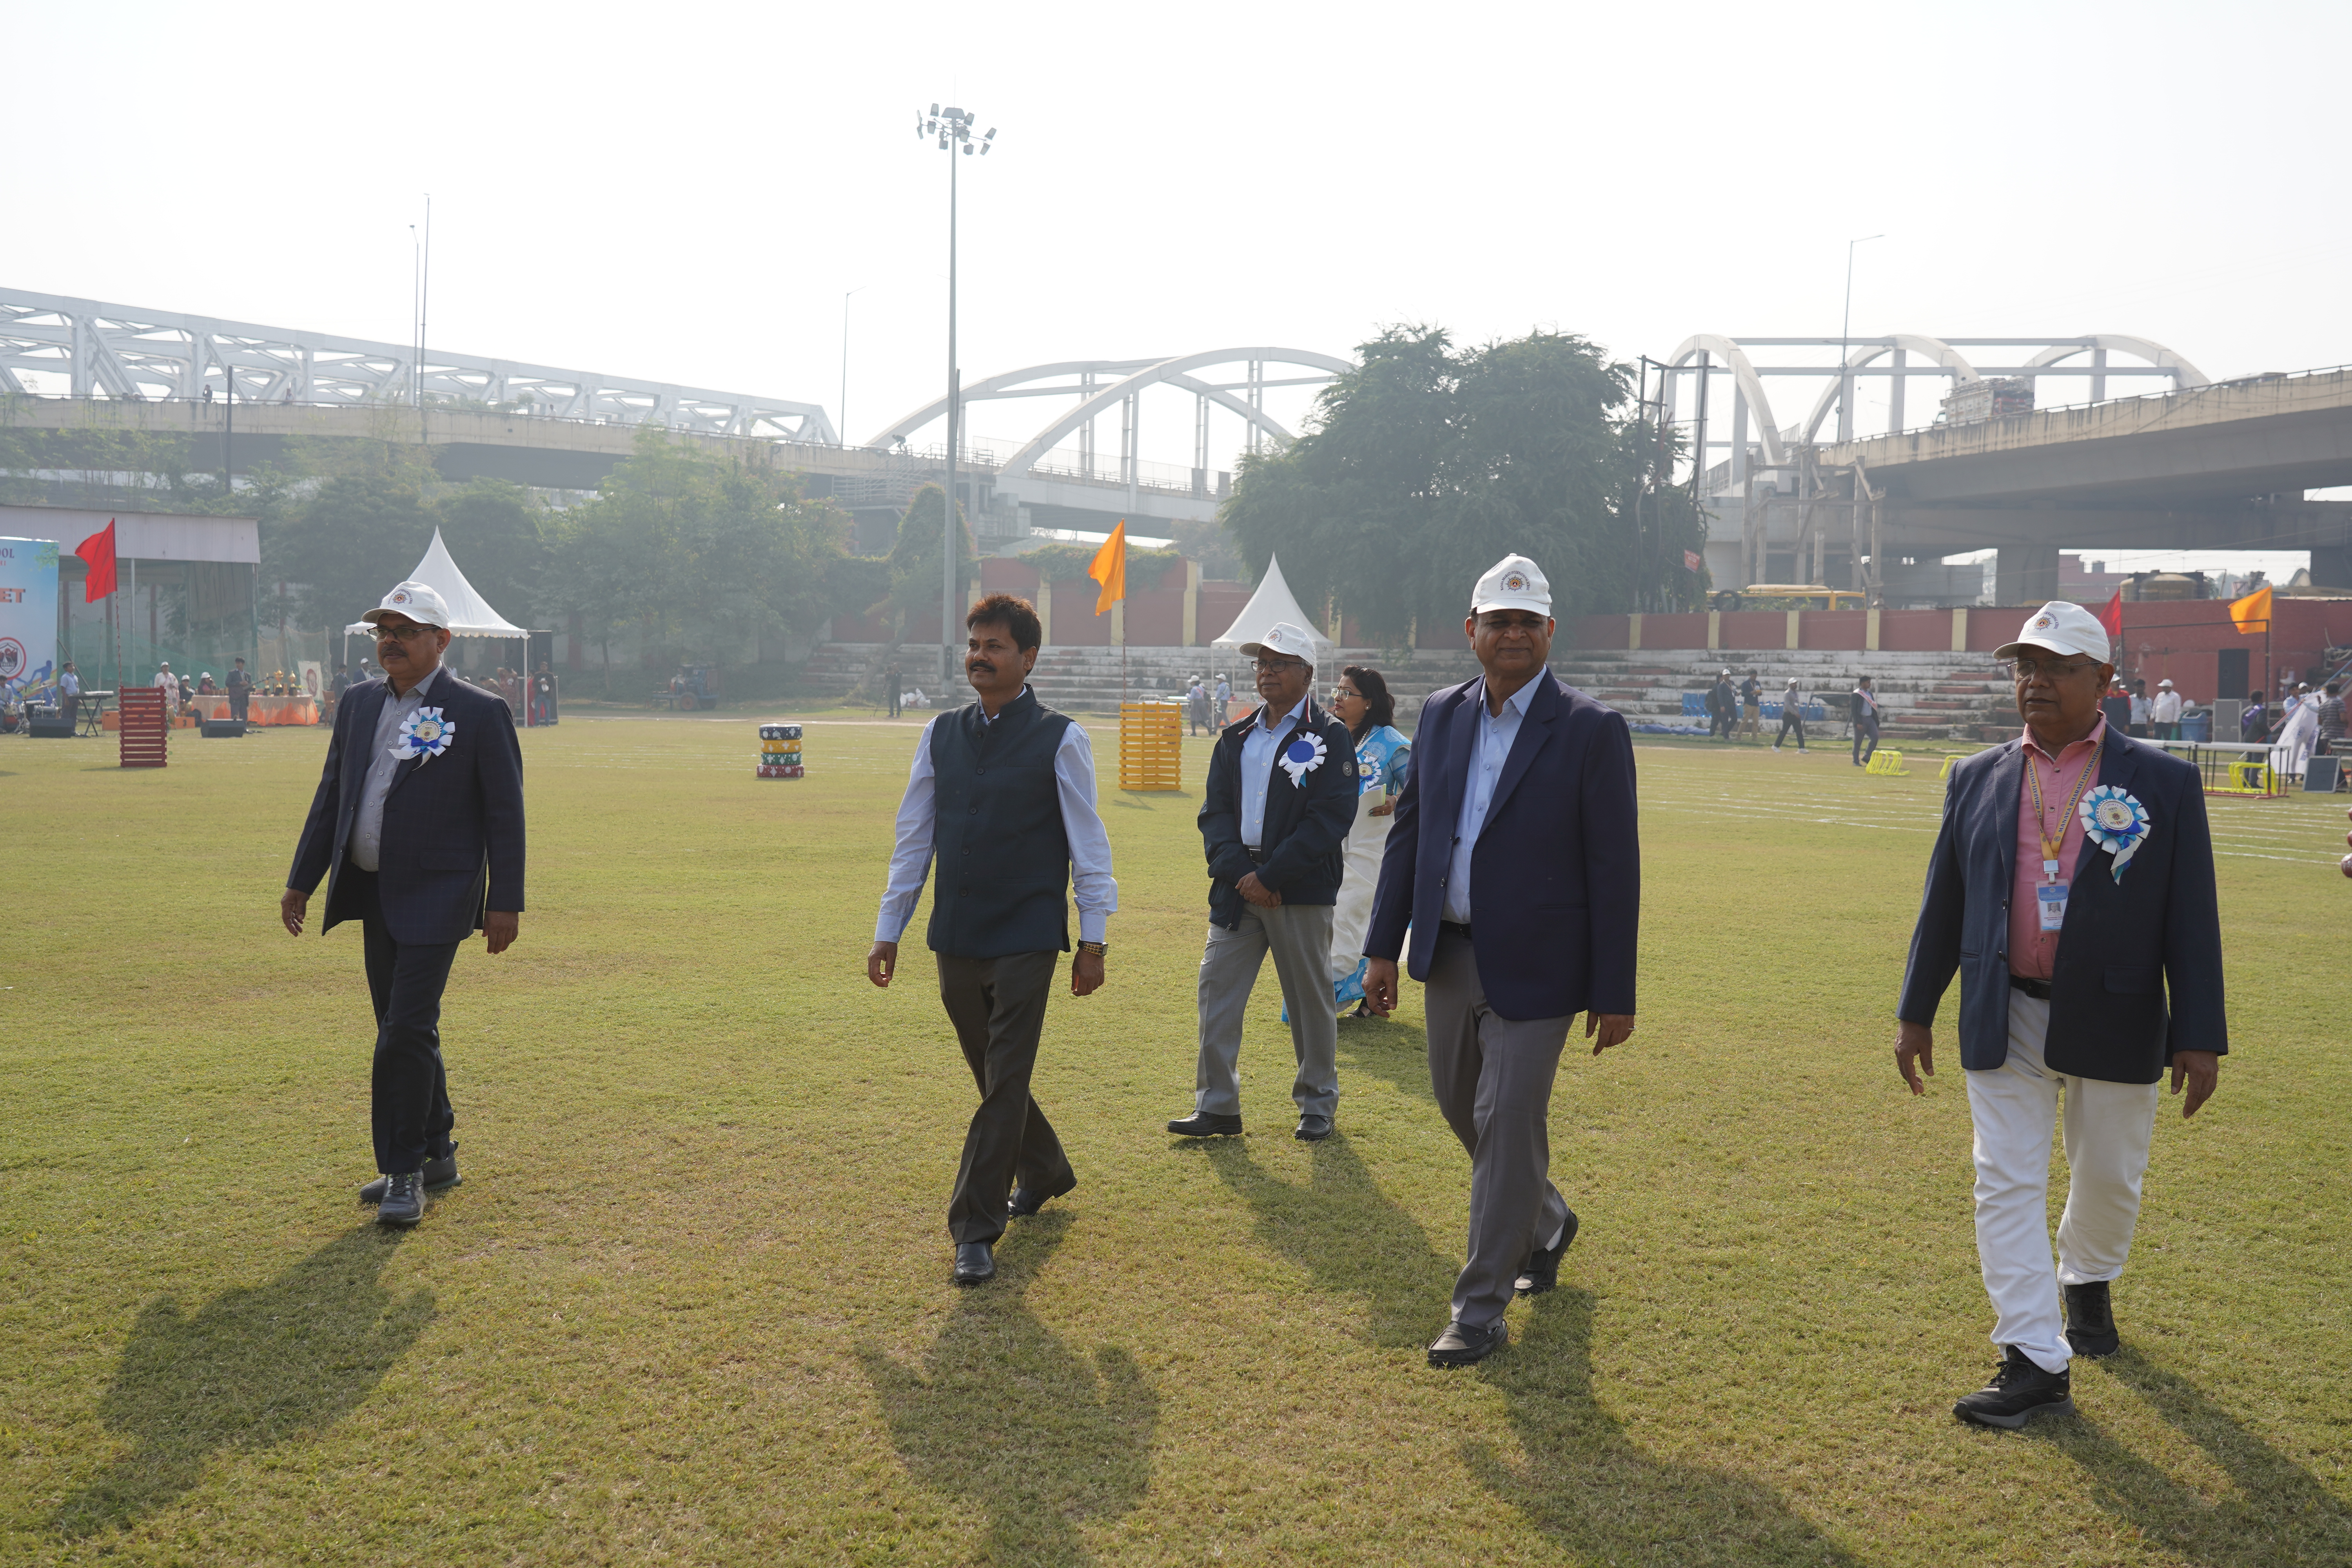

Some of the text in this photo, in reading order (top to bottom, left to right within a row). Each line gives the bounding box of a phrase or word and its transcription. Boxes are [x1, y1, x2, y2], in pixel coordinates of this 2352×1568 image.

[0, 548, 15, 559] OL
[2032, 785, 2040, 809] BHARATI
[2058, 740, 2105, 833] MANAVA BHARATI INTERNATIONAL
